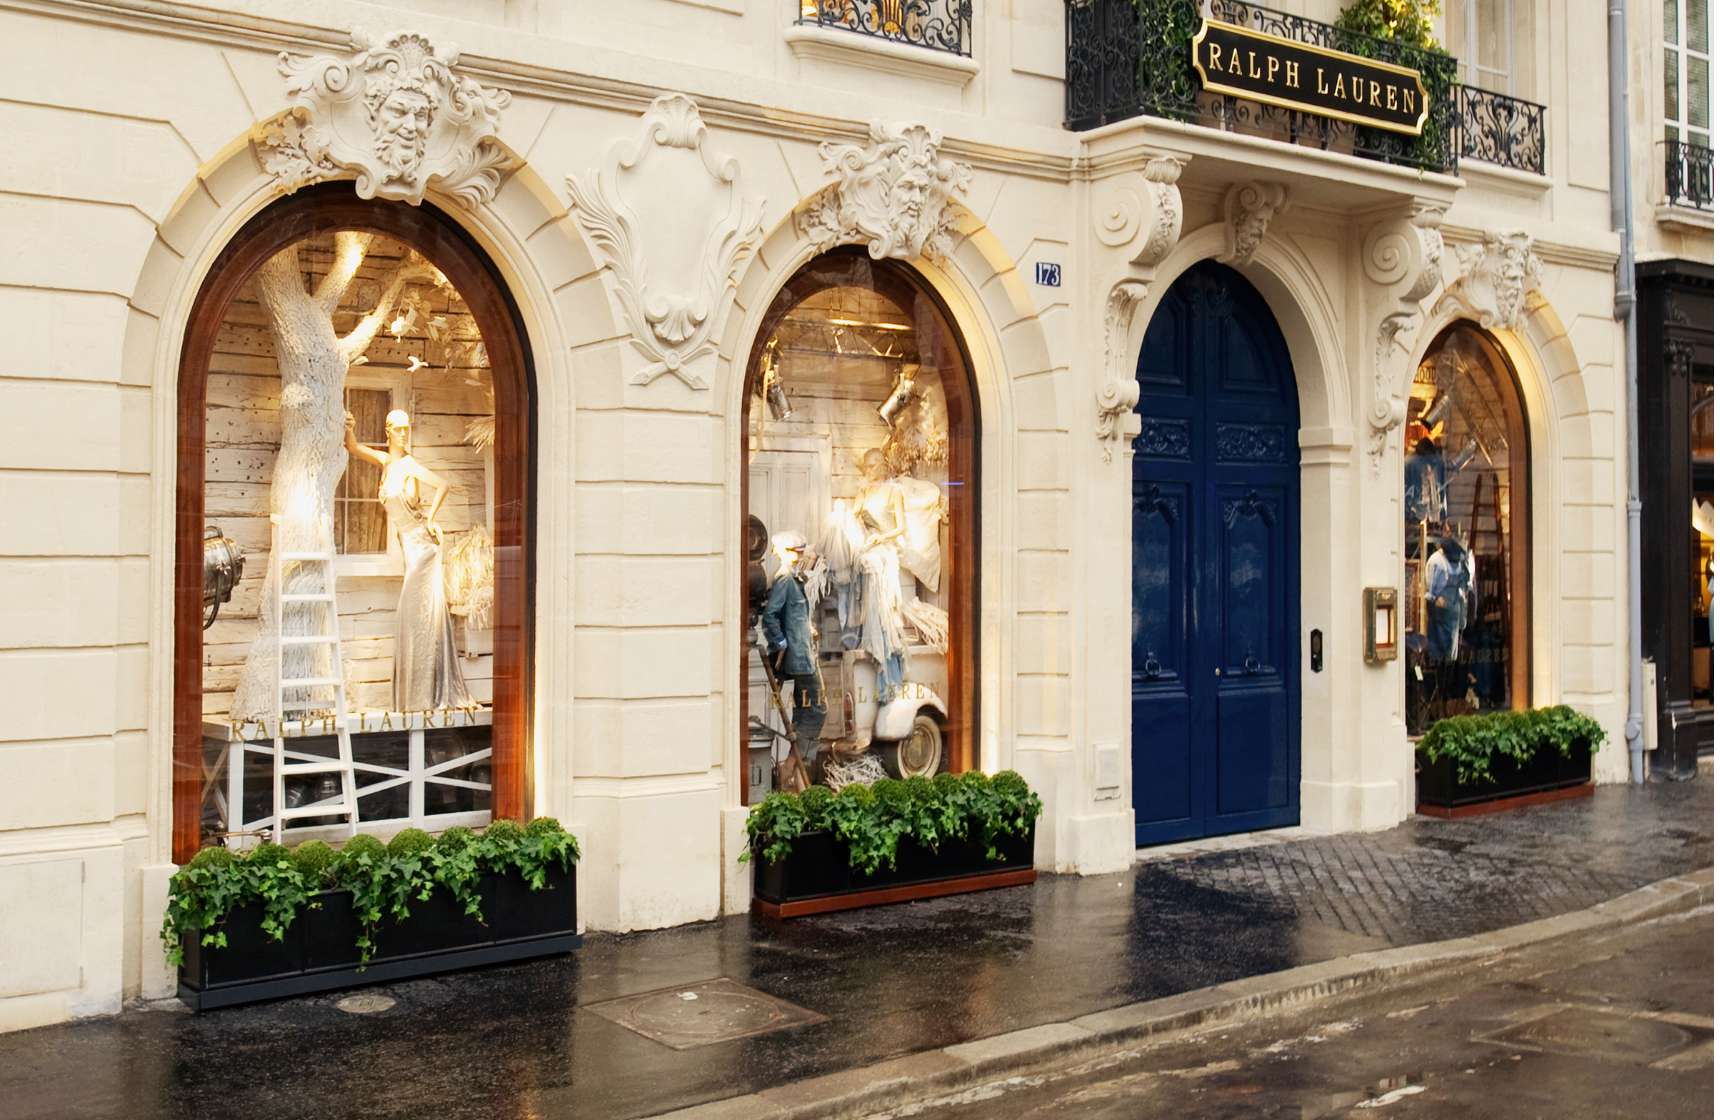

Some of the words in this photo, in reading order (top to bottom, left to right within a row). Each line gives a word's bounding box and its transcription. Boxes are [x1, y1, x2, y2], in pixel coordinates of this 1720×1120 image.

[1208, 42, 1300, 89] RALPH
[1316, 67, 1415, 114] LAUREN
[1038, 263, 1059, 286] 173
[230, 716, 337, 741] RALPH
[360, 707, 479, 731] LAUREN
